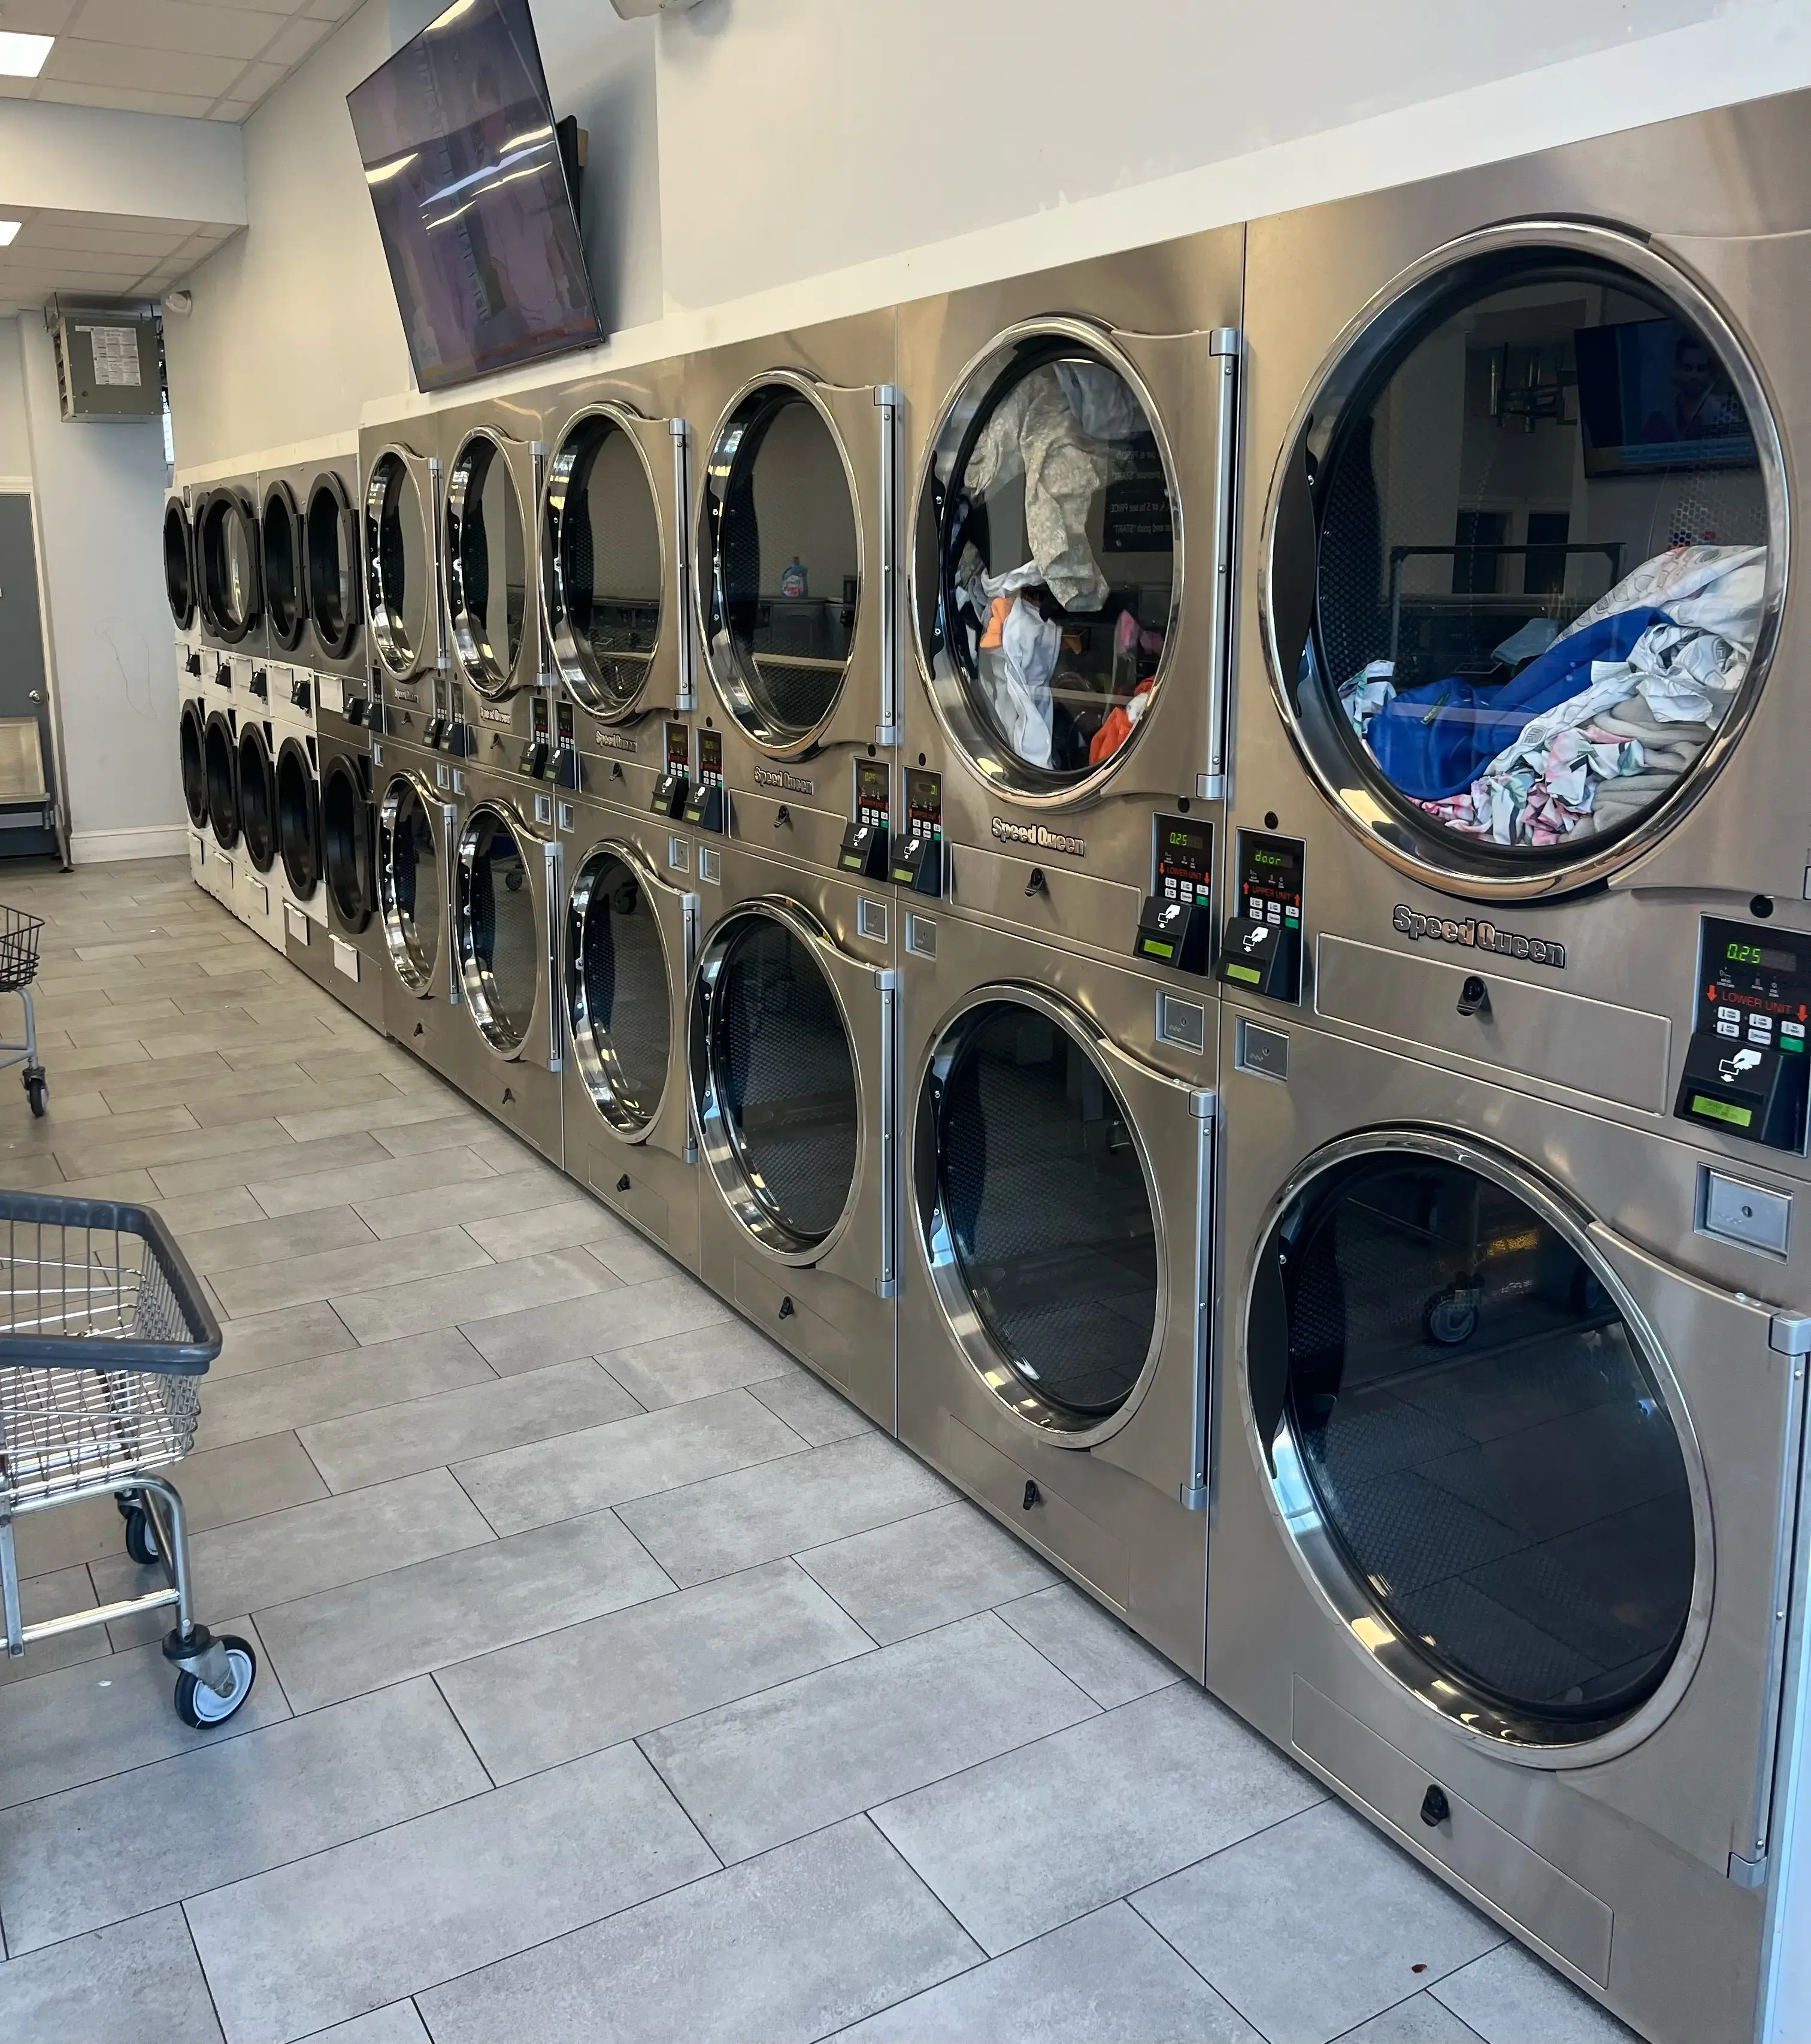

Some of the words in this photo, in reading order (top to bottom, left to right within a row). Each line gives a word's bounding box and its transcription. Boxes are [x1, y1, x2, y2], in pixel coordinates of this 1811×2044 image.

[755, 765, 783, 788] Speed
[991, 816, 1037, 844] Speed
[1037, 823, 1086, 857] Queen
[1255, 850, 1281, 865] door
[1167, 867, 1187, 877] LOWER
[1188, 871, 1203, 880] UNIT
[1252, 886, 1274, 897] UPPER
[1276, 890, 1291, 900] UNIT
[1393, 904, 1476, 947] Speed
[1475, 920, 1567, 970] Queen
[1722, 990, 1762, 1008] LOWER
[1765, 1001, 1792, 1013] UNIT
